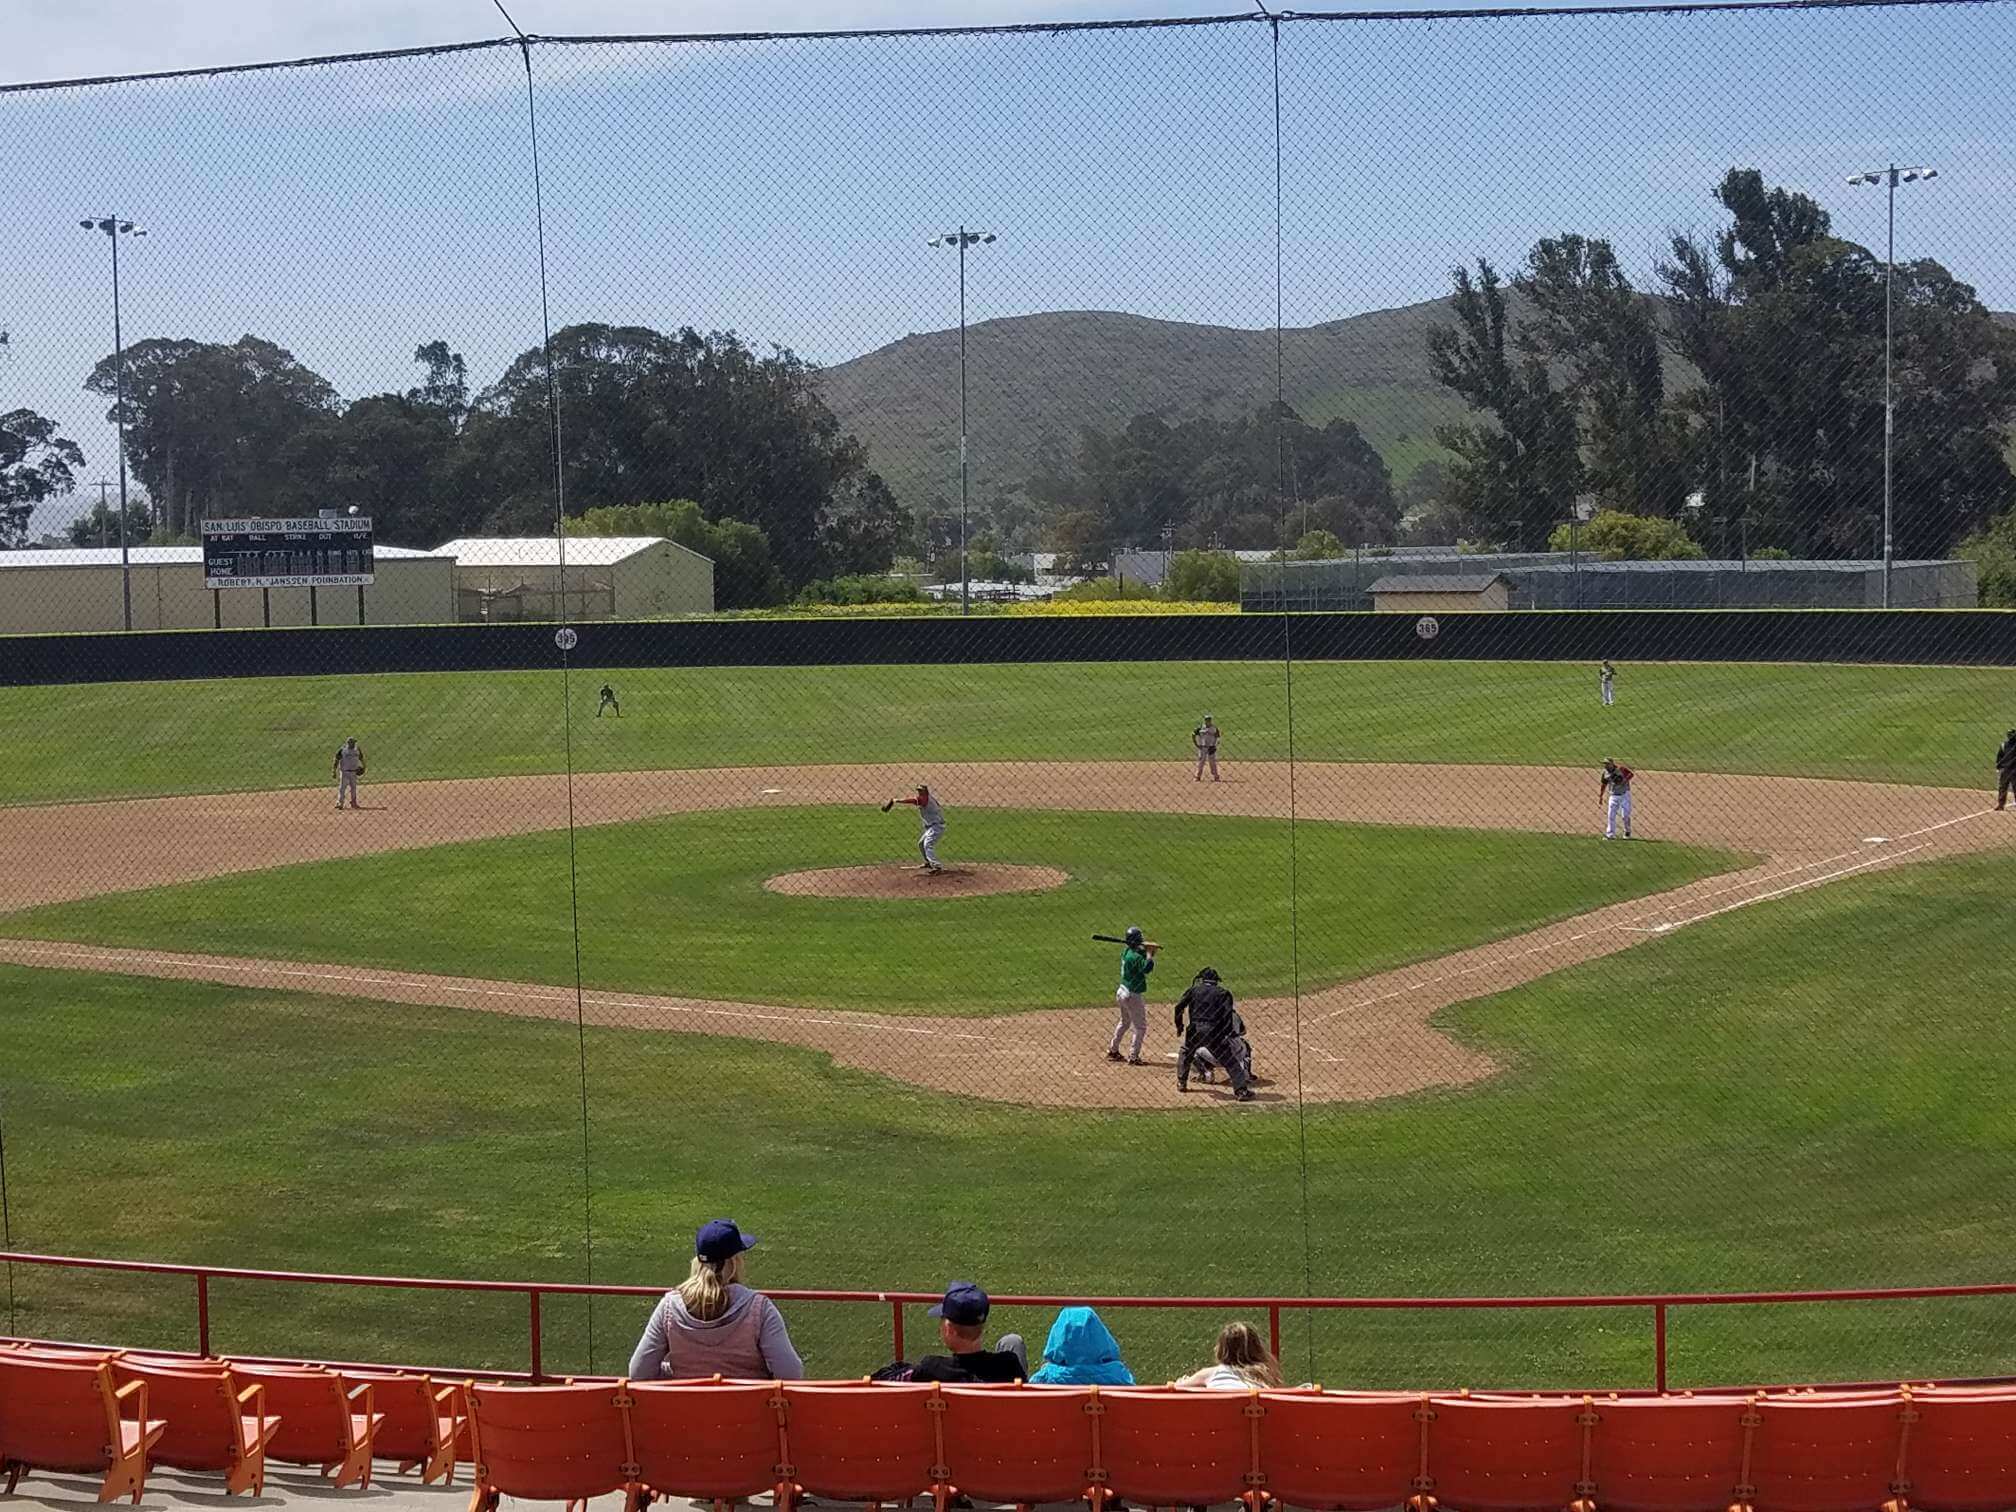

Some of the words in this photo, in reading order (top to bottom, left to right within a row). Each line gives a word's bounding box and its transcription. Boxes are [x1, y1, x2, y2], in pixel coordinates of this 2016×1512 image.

[204, 521, 223, 532] SAN
[226, 521, 246, 532] LUIS
[250, 520, 282, 531] OBISPO
[286, 520, 330, 530] BASEBALL
[334, 519, 371, 530] STADIUM
[208, 558, 233, 566] GUEST
[210, 567, 233, 576] HOME
[217, 578, 251, 587] ROBERT
[311, 576, 363, 584] FOUNDATION
[1418, 624, 1437, 633] 365
